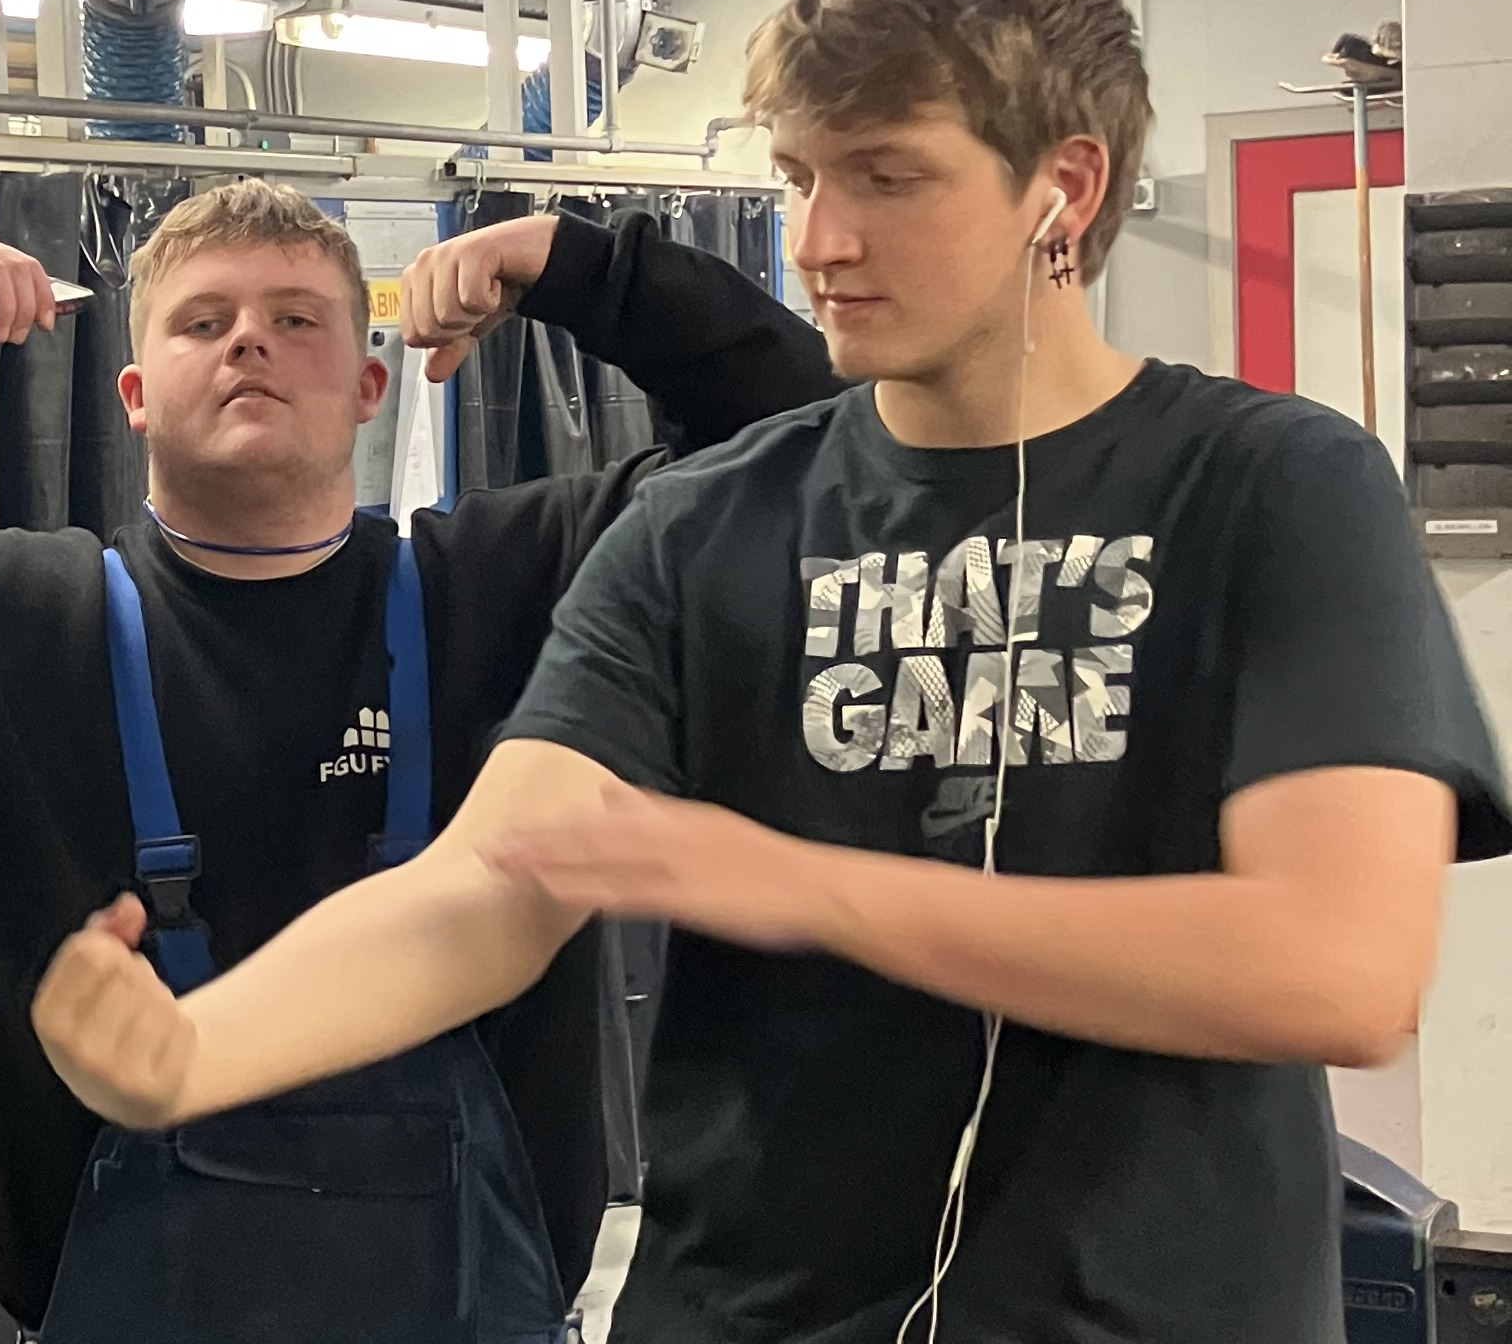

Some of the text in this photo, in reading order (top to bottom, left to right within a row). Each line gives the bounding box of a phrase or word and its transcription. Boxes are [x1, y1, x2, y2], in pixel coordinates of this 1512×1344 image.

[369, 291, 401, 317] ABIN
[800, 535, 1154, 658] THAT'S
[802, 643, 1134, 772] GAME
[319, 753, 366, 783] FGU
